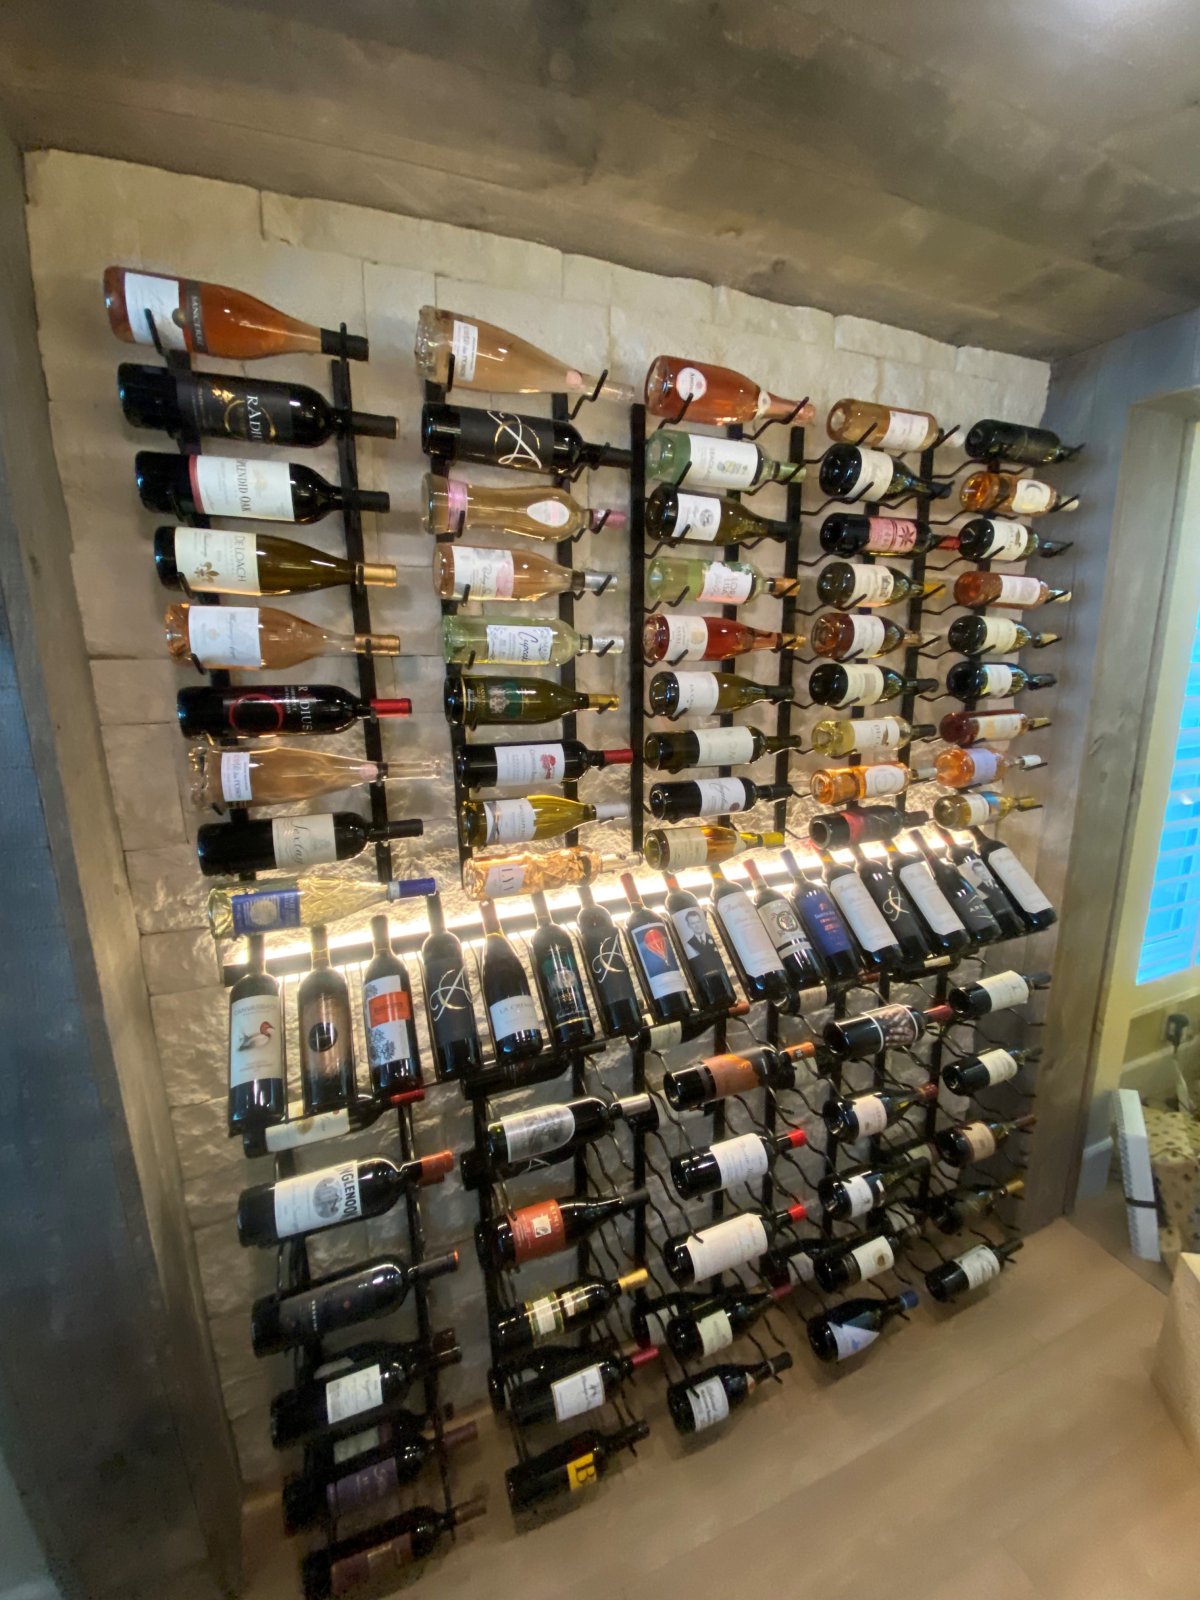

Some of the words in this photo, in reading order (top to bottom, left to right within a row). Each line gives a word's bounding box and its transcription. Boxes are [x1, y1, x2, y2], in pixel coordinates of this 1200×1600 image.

[246, 394, 264, 440] RADI
[240, 495, 252, 513] OAK
[519, 631, 539, 662] Cupcak
[299, 686, 313, 731] RDIUS
[292, 826, 310, 865] Sextan
[340, 1167, 361, 1219] NGLENOOK
